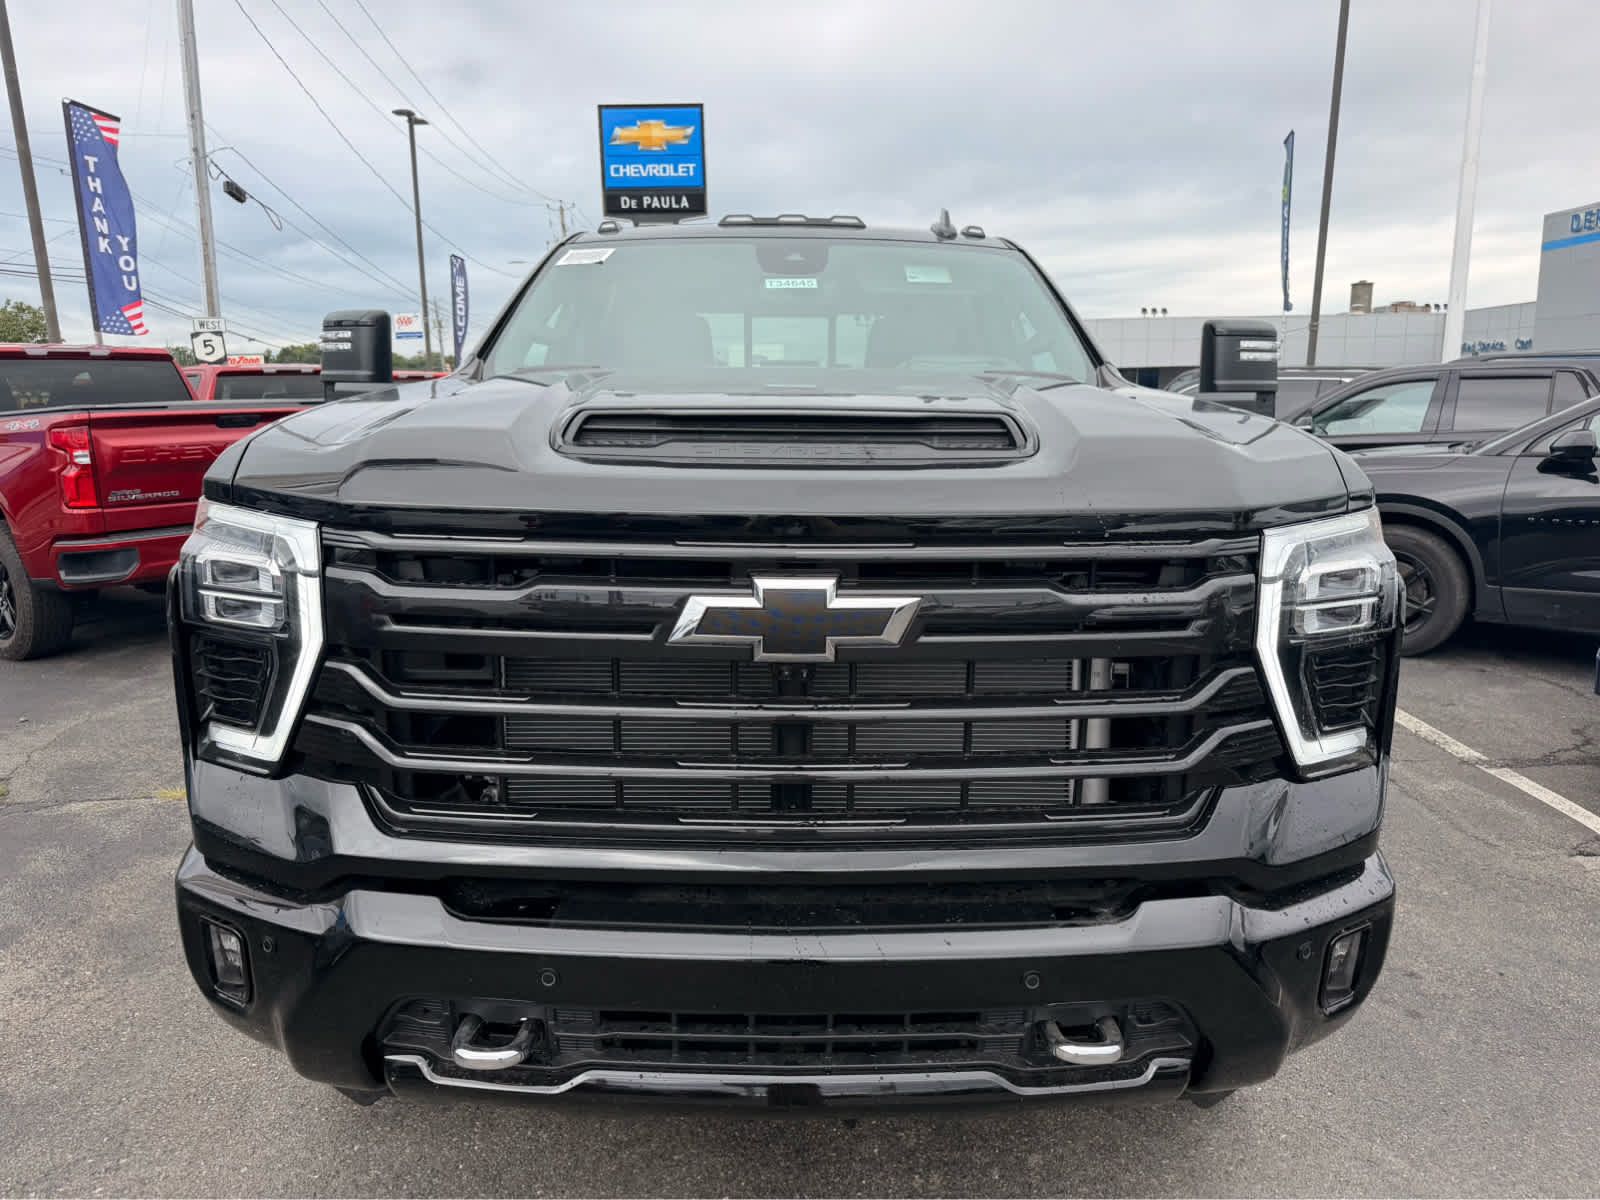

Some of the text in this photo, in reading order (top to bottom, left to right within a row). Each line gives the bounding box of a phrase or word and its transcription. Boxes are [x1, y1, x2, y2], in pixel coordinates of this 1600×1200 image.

[610, 163, 696, 177] CHEVROLET
[84, 155, 112, 255] THANK
[642, 195, 690, 209] PAULA
[116, 234, 137, 291] YOU
[455, 276, 466, 344] LCOME
[198, 320, 222, 330] WEST
[203, 339, 215, 356] 5
